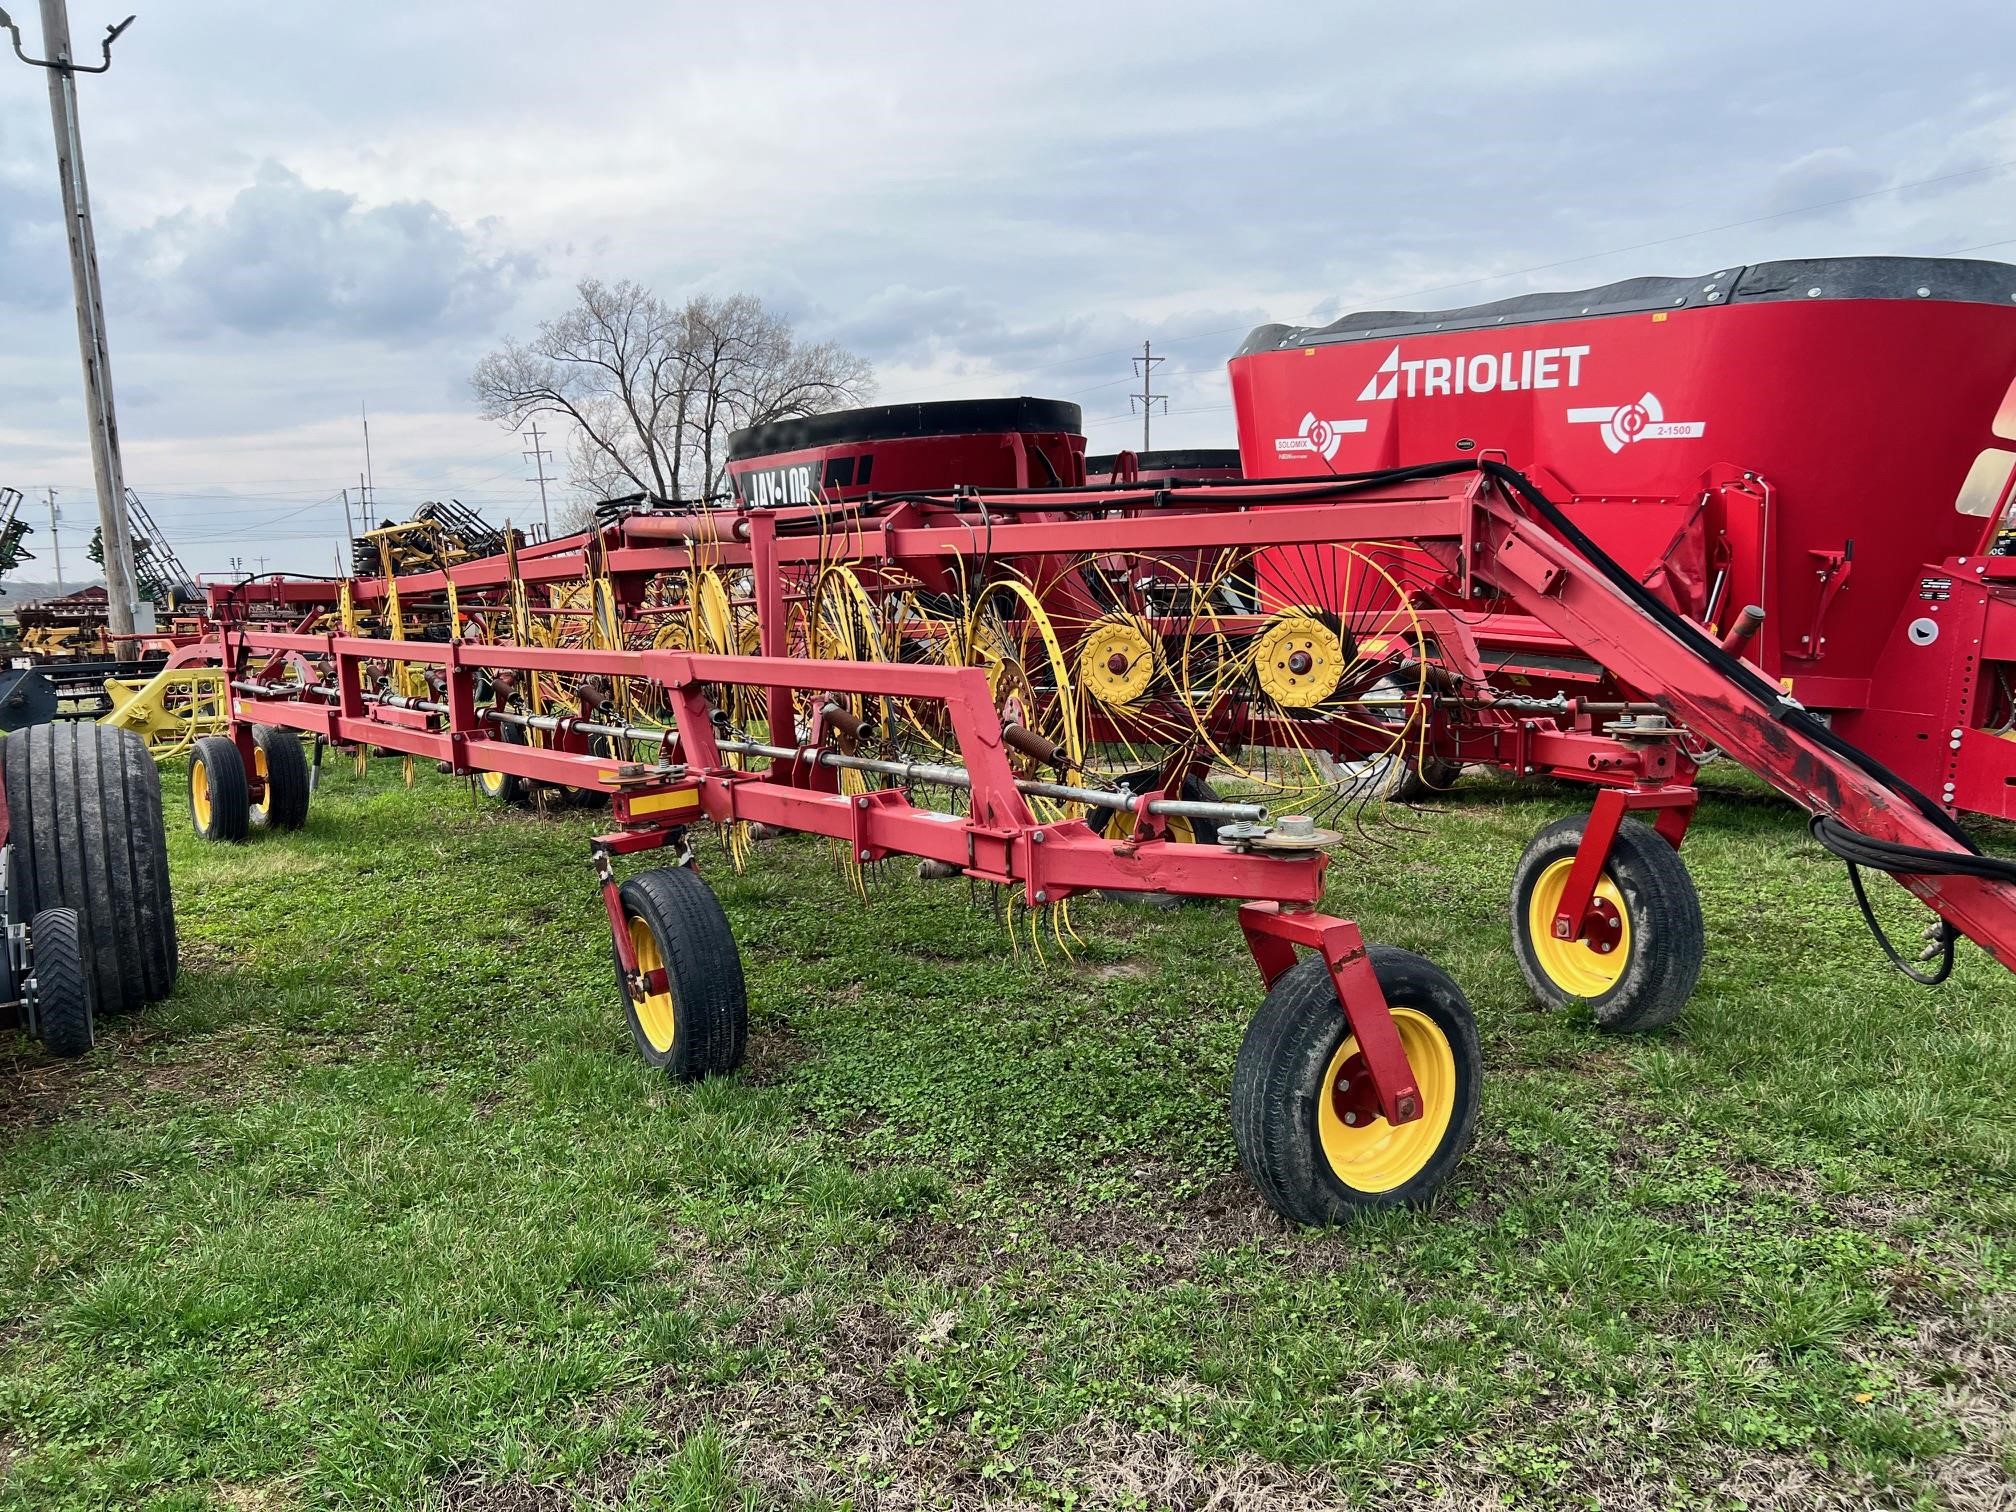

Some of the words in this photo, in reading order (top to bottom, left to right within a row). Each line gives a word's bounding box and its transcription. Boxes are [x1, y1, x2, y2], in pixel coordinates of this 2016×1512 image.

[1400, 344, 1590, 398] TRIOLIET
[1657, 425, 1691, 436] 2-1500
[1278, 440, 1308, 449] SOLOMIX
